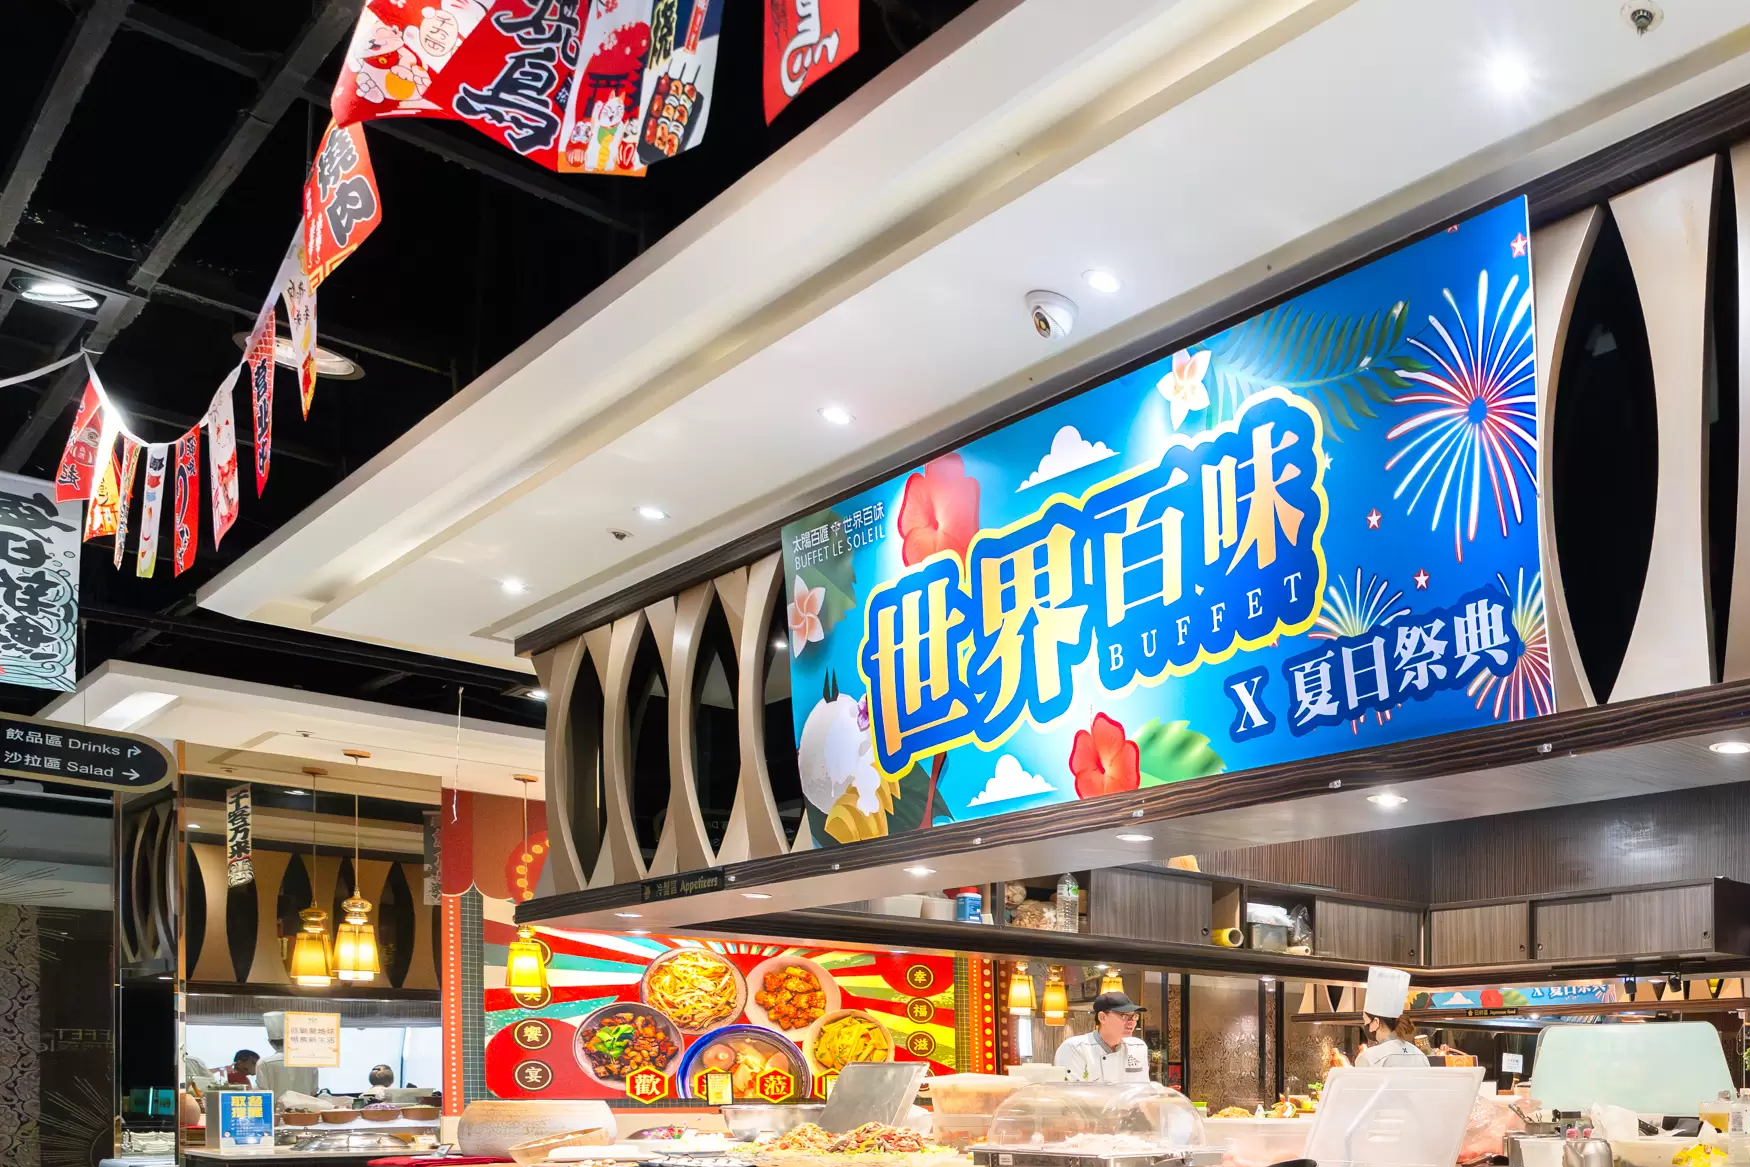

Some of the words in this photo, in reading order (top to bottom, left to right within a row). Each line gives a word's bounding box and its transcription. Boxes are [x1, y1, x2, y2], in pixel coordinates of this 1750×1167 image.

[792, 523, 830, 553] 太陽百匯
[843, 501, 885, 534] 世界百味
[794, 545, 830, 571] BUFFET
[832, 539, 844, 557] LE
[846, 523, 886, 552] SOLEIL
[871, 421, 1302, 758] 世界百味
[1108, 571, 1303, 674] BUFFET
[1230, 677, 1269, 734] X
[1290, 599, 1511, 722] 夏日祭典
[4, 749, 62, 771] 沙拉區
[67, 760, 114, 778] Salad
[5, 727, 63, 748] 飲品區
[68, 737, 121, 757] Drinks
[680, 875, 718, 894] Appetizers
